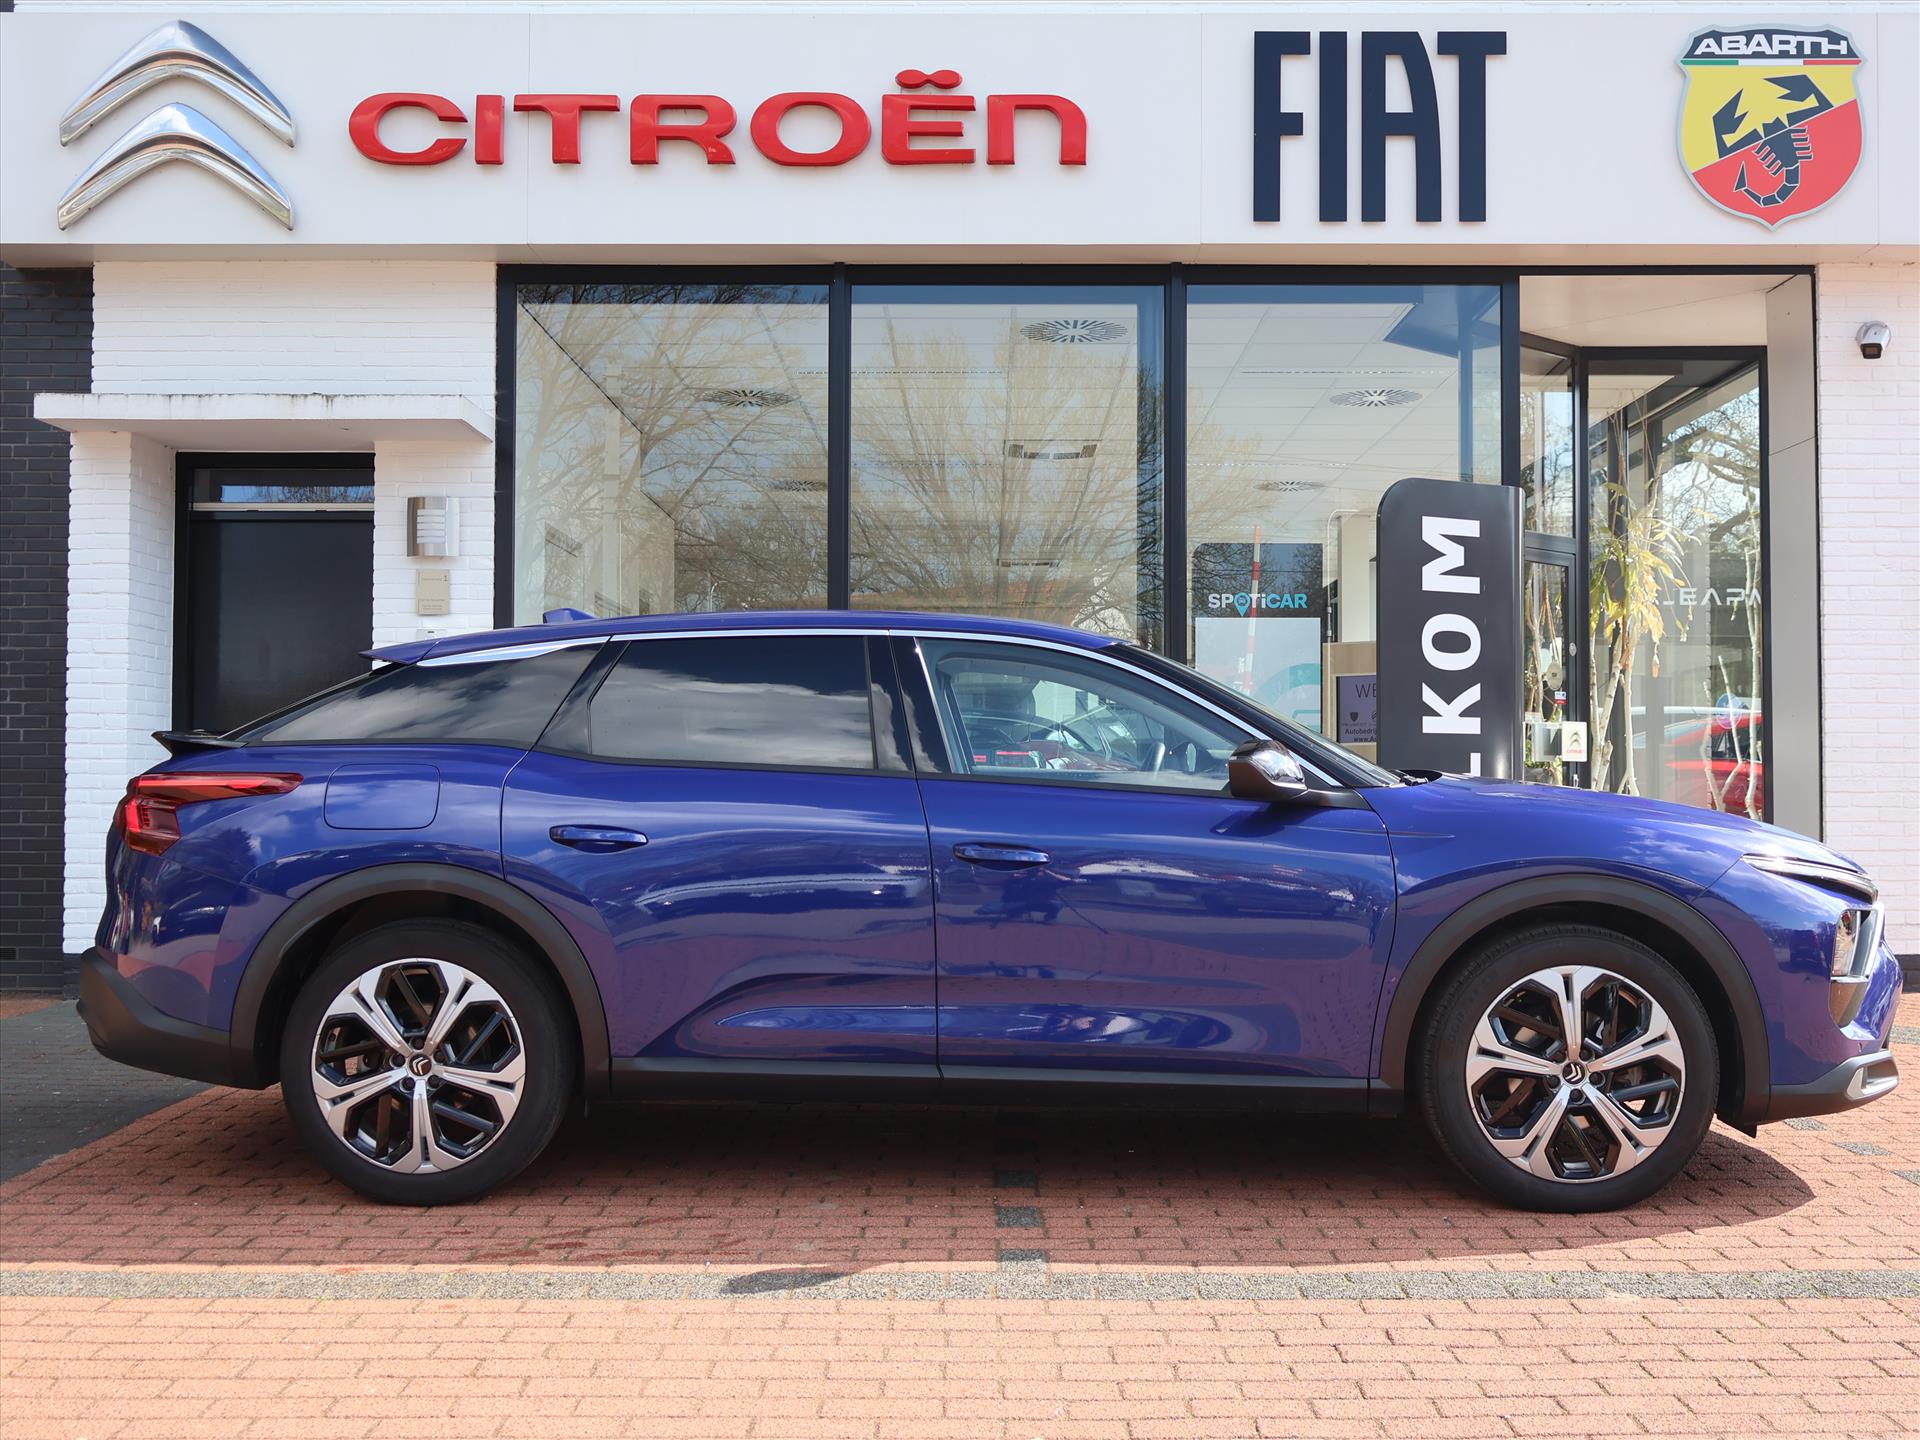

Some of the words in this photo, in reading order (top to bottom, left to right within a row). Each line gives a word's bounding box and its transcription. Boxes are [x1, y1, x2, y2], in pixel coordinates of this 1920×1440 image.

[1693, 33, 1848, 55] ABARTH
[350, 69, 1088, 166] CITROËN
[1253, 31, 1506, 223] FIAT
